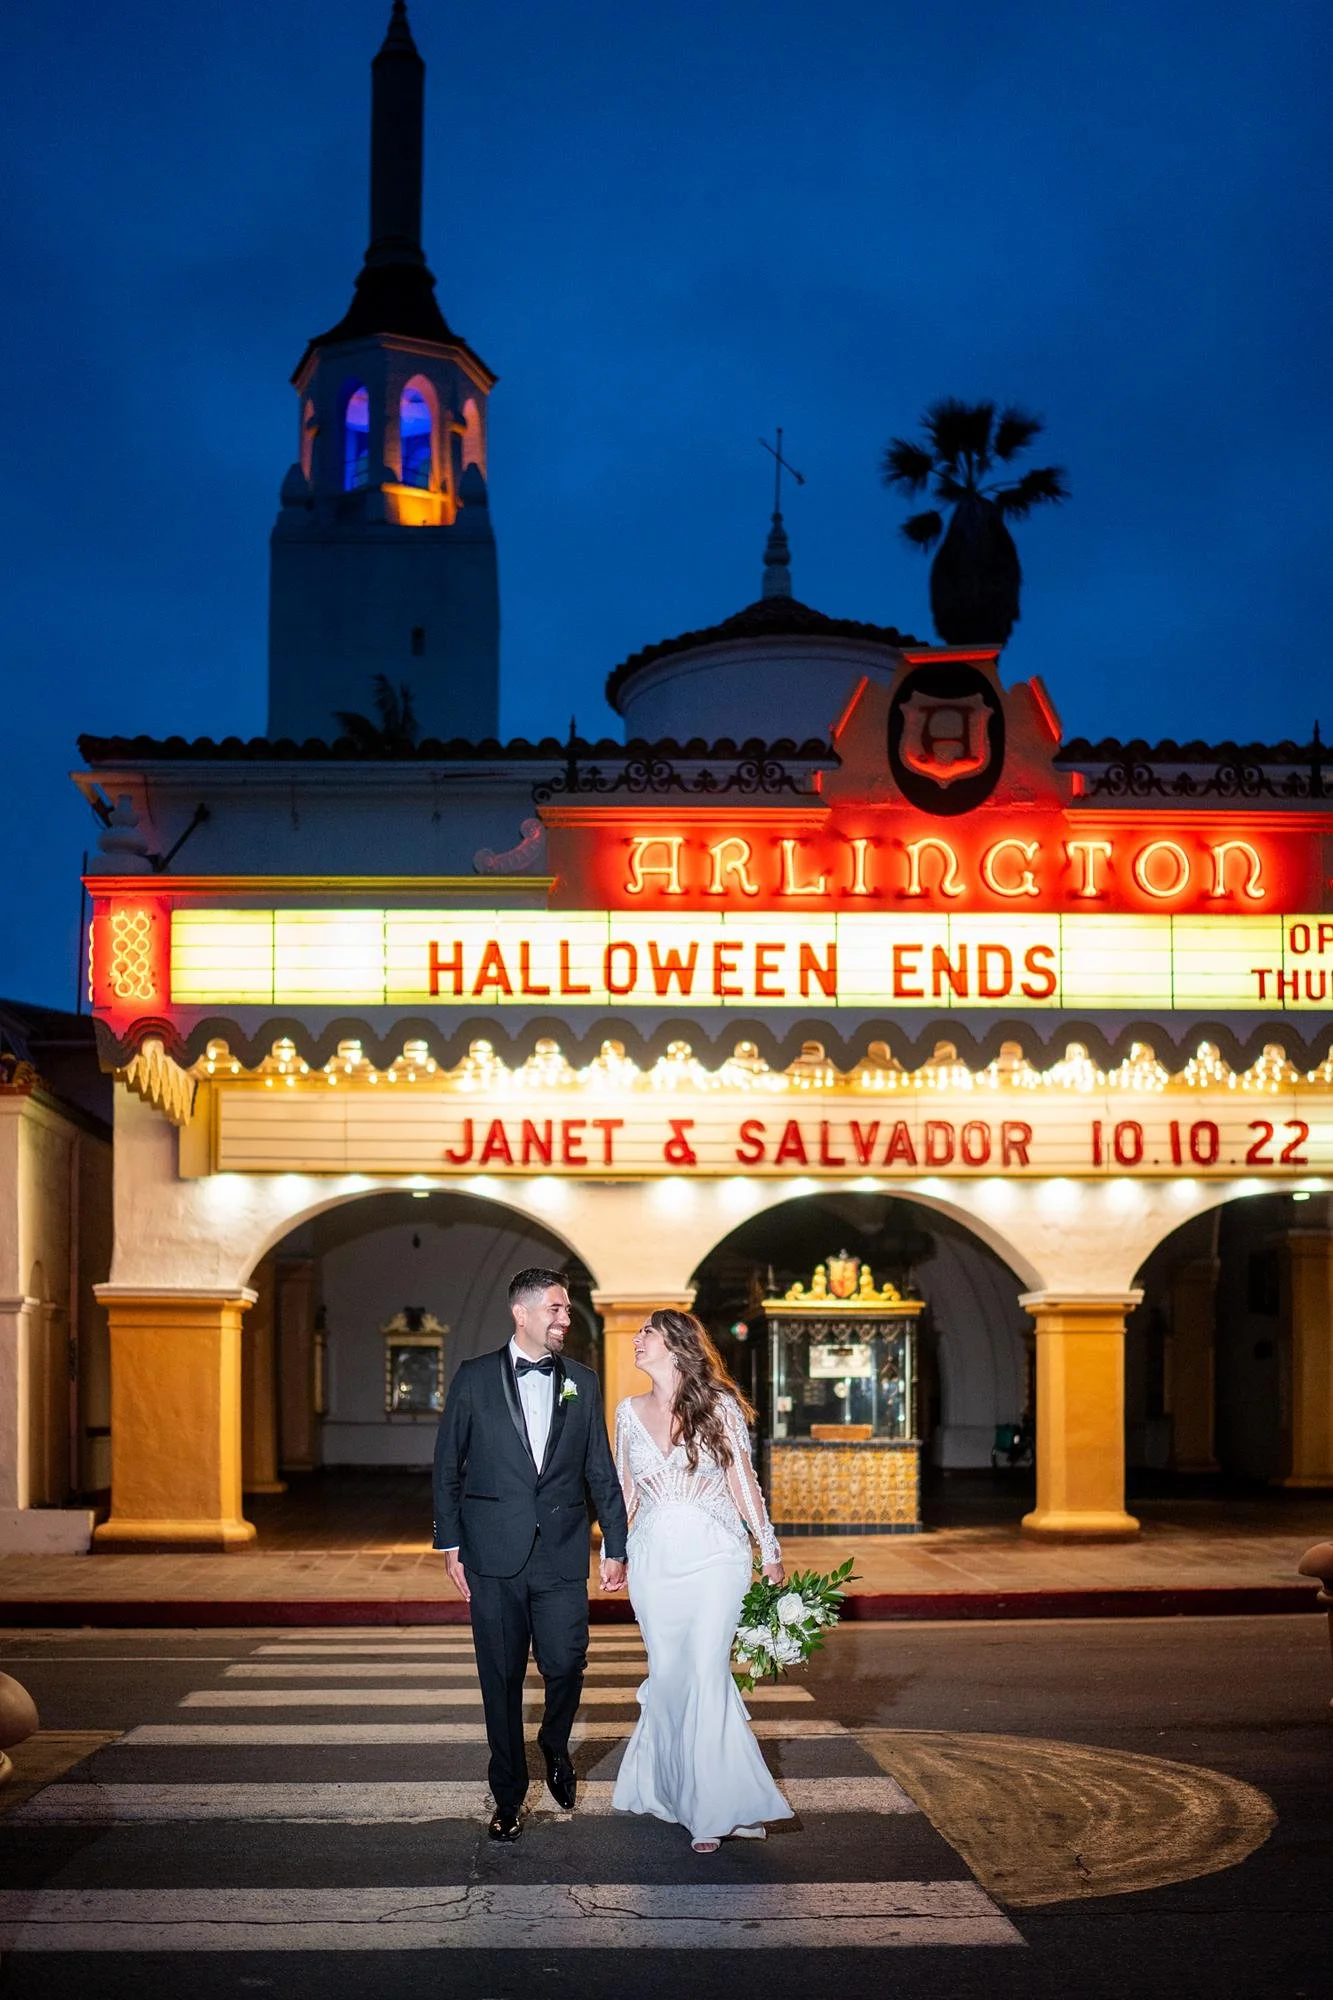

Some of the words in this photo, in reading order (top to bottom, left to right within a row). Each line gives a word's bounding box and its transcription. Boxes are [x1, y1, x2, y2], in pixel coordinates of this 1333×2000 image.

[624, 837, 1266, 899] ARLINGTON
[428, 940, 838, 996] HALLOWEEN
[893, 944, 1057, 999] ENDS
[1251, 969, 1333, 1000] THU
[445, 1118, 624, 1166] JANET
[663, 1119, 697, 1166] &
[736, 1119, 1033, 1167] SALVADOR
[1092, 1119, 1310, 1167] 10.10.22
